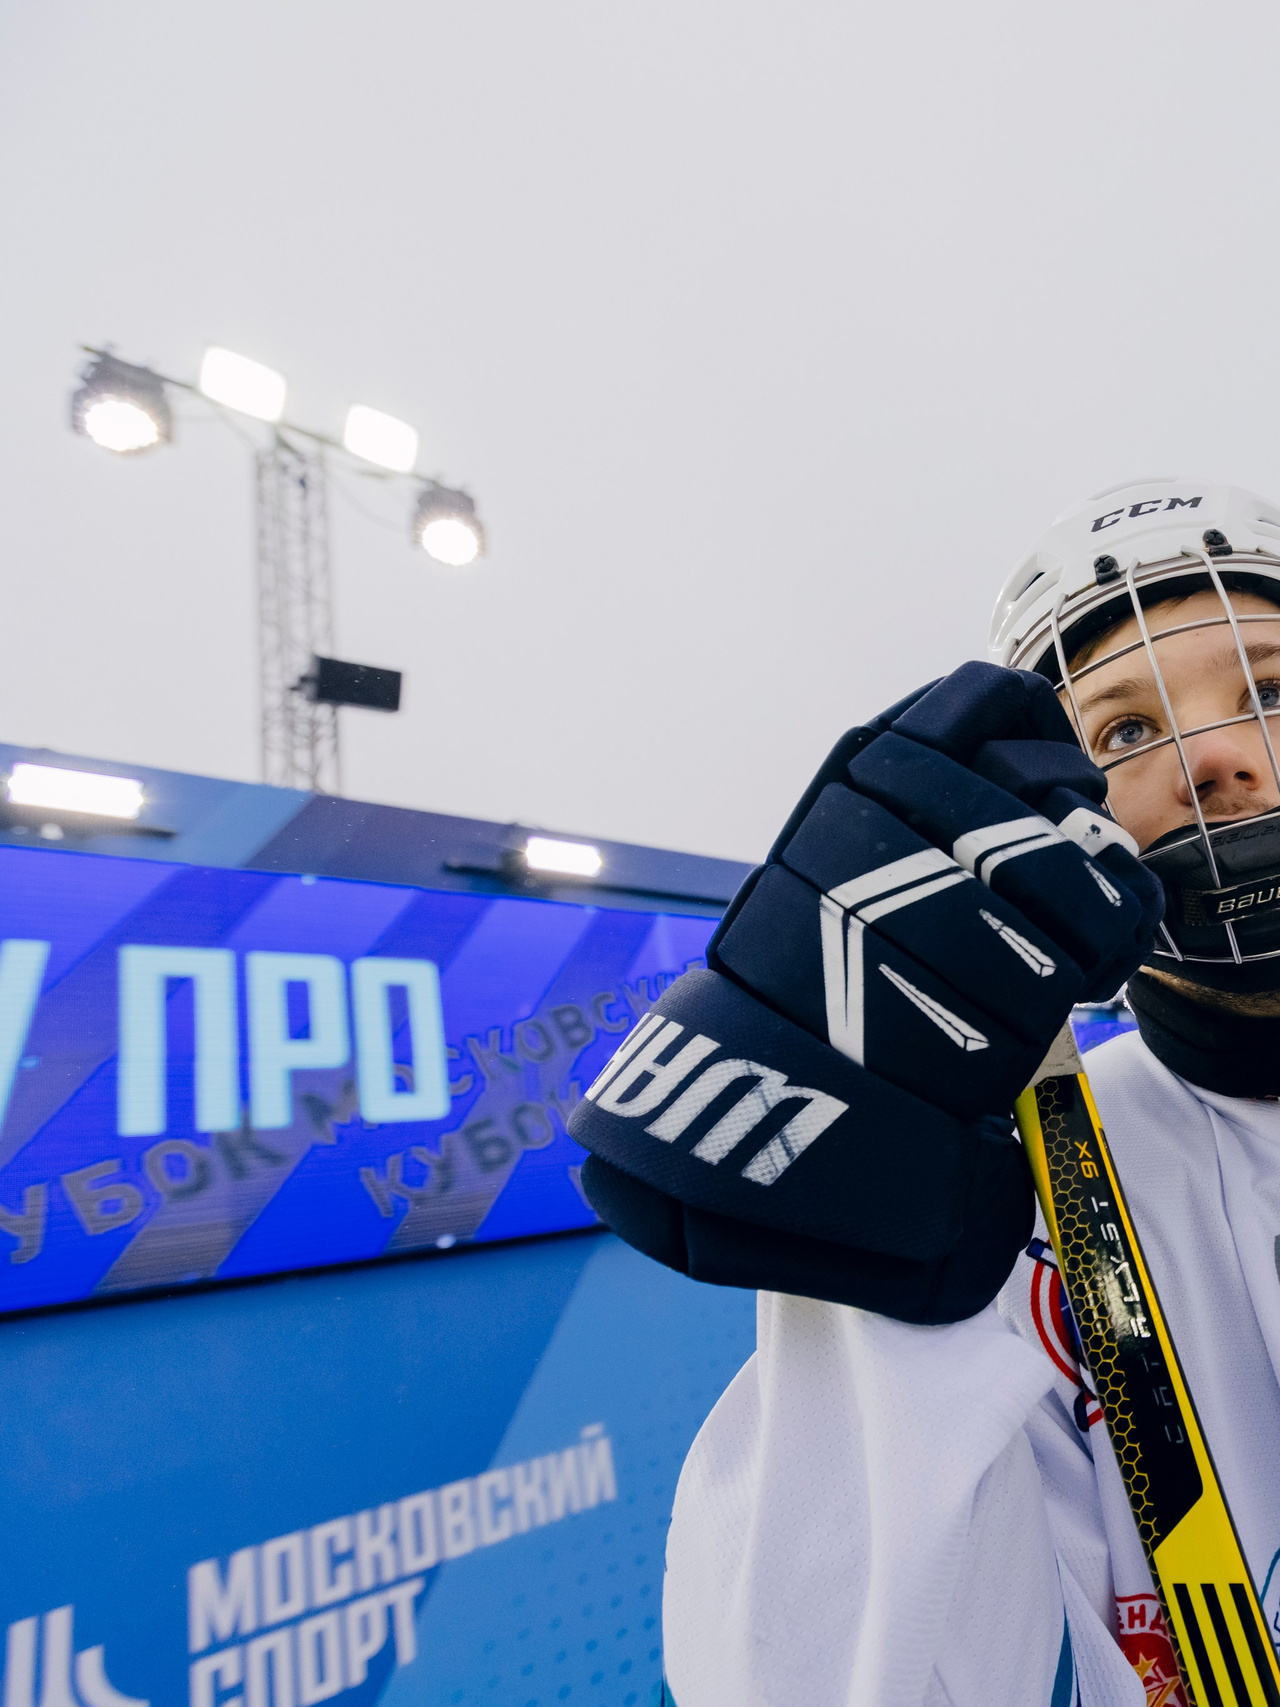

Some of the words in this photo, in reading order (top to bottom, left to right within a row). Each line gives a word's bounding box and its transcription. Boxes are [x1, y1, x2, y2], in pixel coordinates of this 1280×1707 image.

[1091, 496, 1204, 533] CCM
[117, 943, 451, 1137] ПРО
[584, 1013, 849, 1186] WAR
[0, 1106, 290, 1266] УБОК
[1074, 1141, 1100, 1179] 9X
[1091, 1196, 1184, 1444] CATALYST
[189, 1422, 618, 1654] МОСКОВСКИЙ
[189, 1577, 426, 1707] СПОРТ
